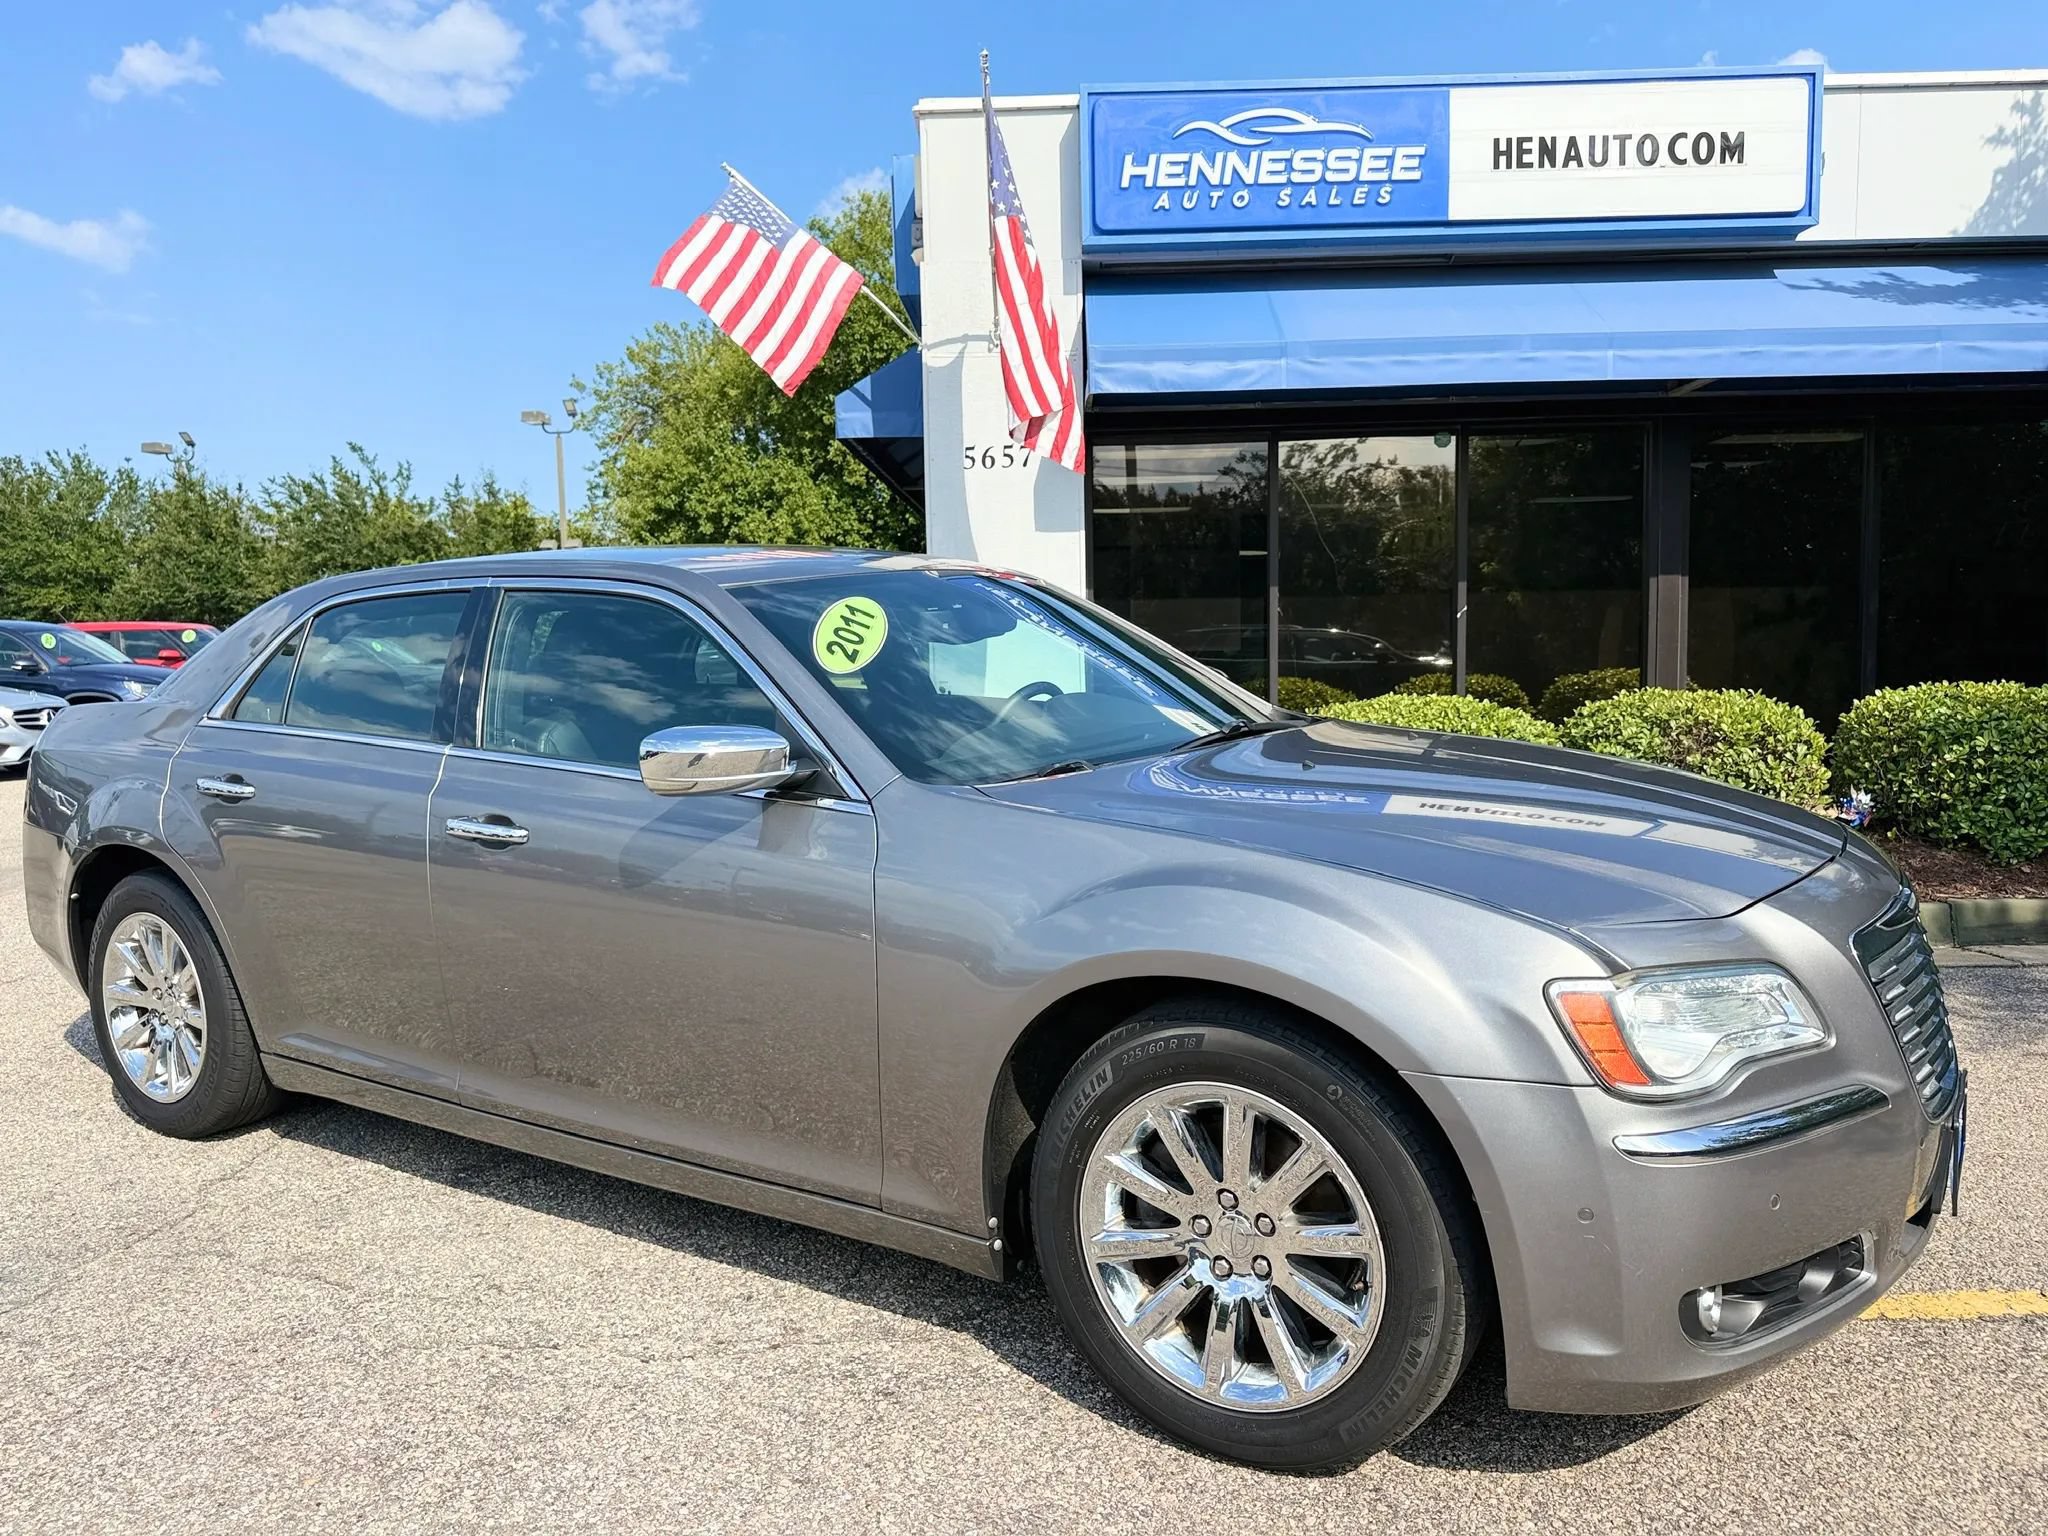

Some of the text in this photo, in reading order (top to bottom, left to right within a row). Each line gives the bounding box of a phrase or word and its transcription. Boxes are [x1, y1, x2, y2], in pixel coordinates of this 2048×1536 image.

[1120, 143, 1427, 188] HENNESSEE
[1153, 183, 1394, 211] AUTO SALES
[963, 444, 1035, 469] 5657
[826, 603, 875, 664] 2011
[1121, 1037, 1197, 1067] 225/60 R 18
